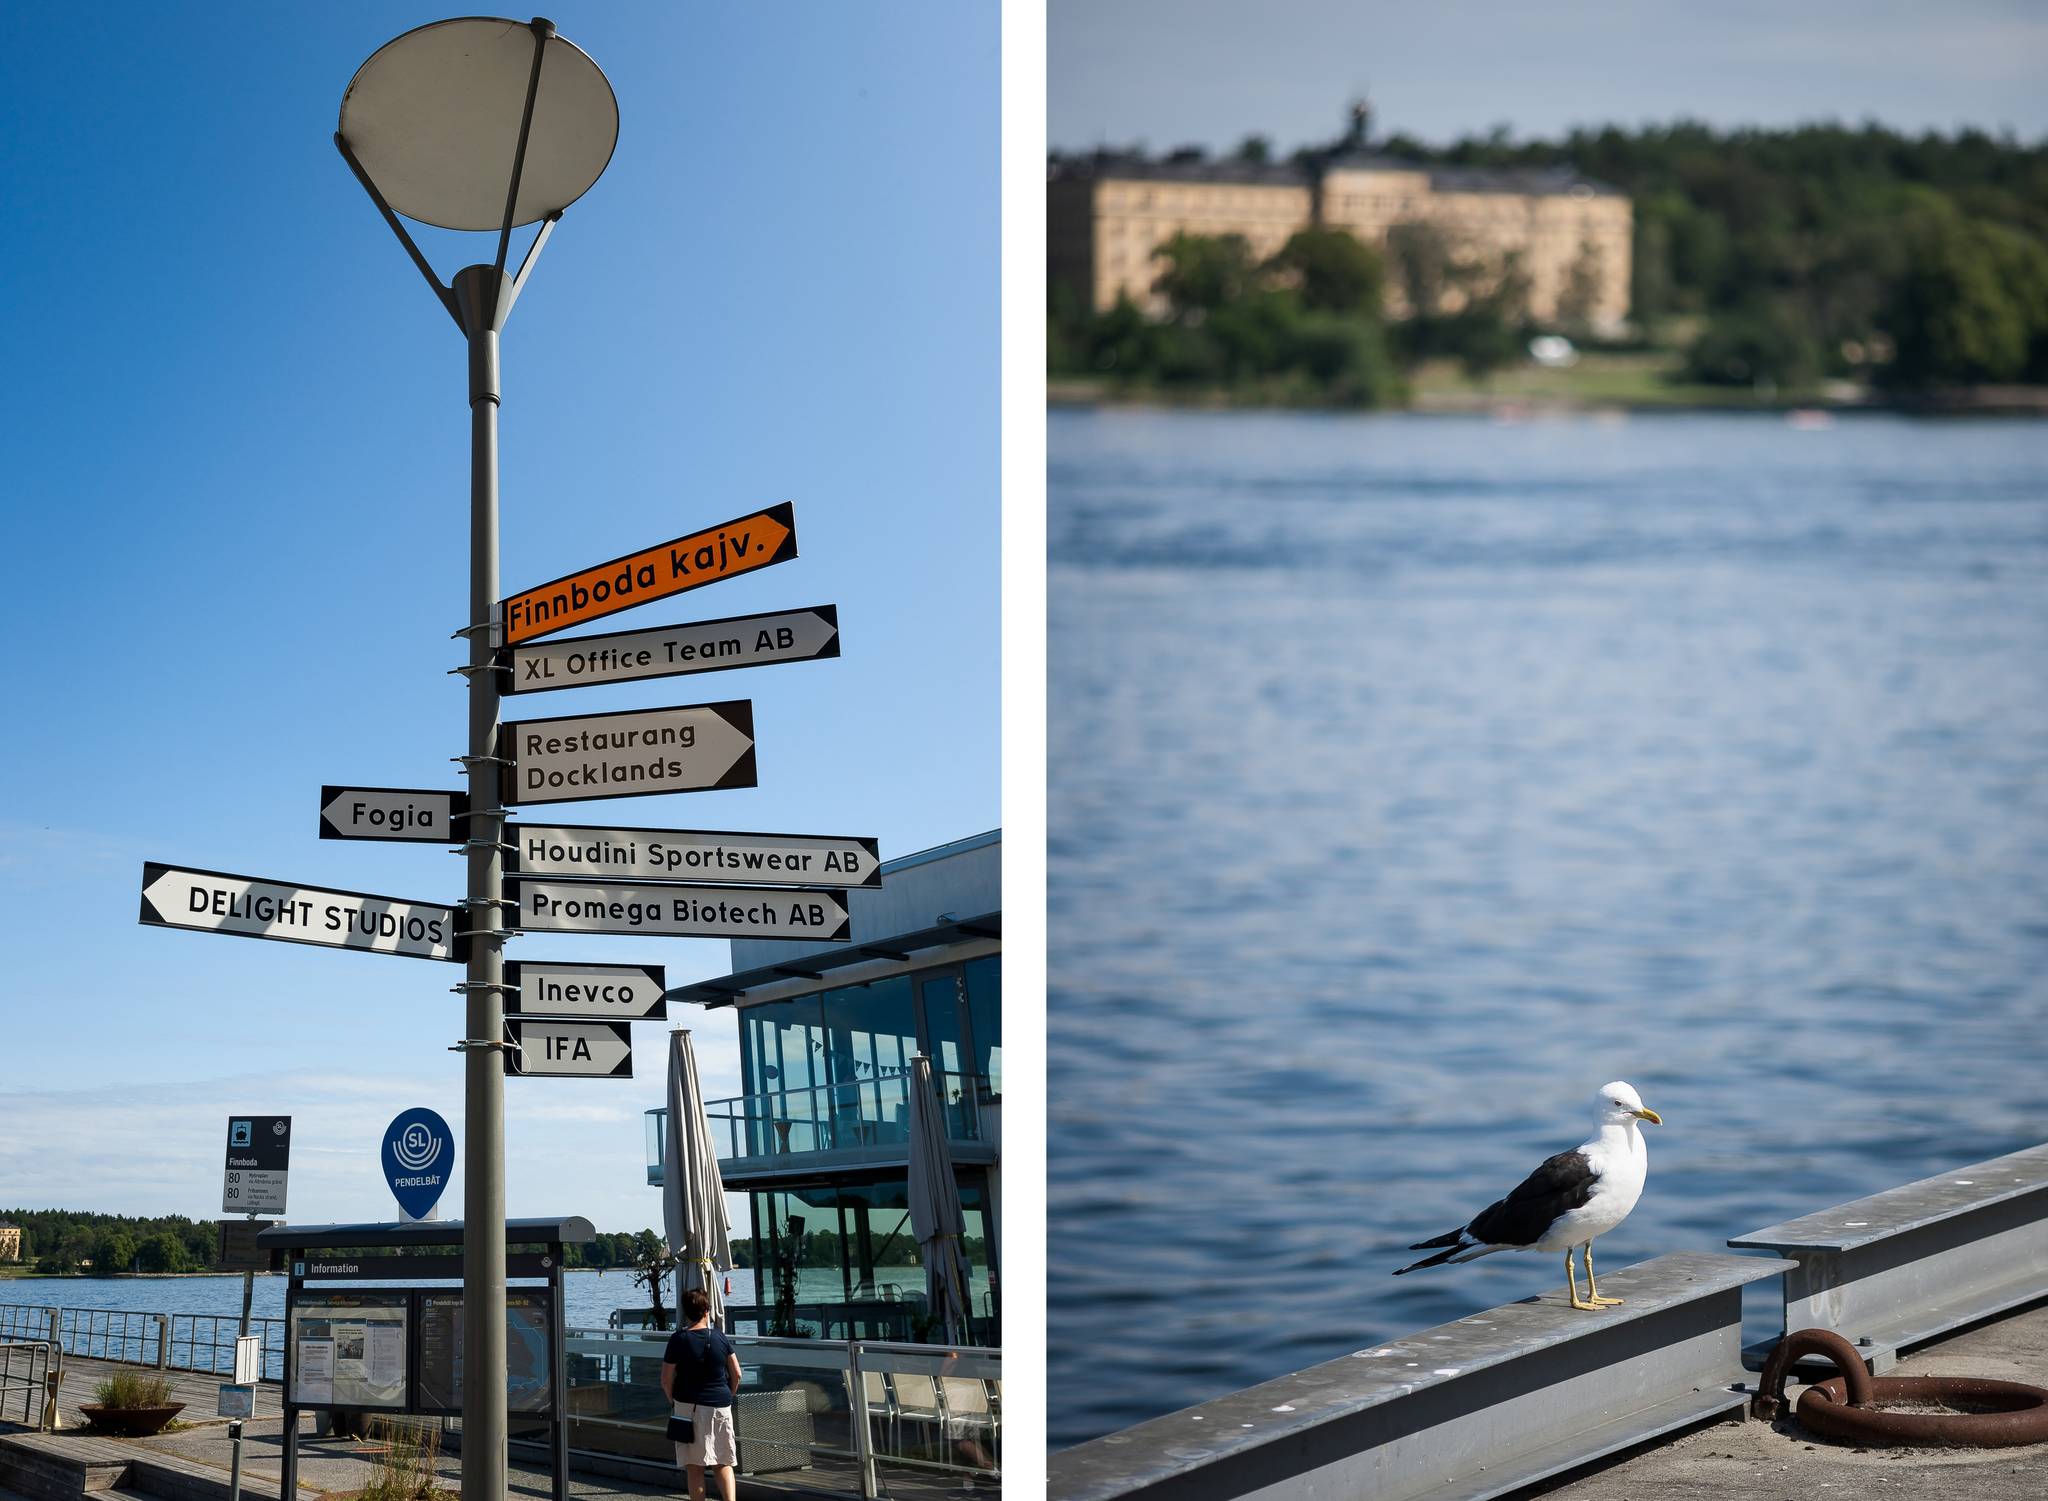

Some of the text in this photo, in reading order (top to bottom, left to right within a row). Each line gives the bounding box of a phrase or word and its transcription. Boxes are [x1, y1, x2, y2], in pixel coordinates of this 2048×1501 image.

[509, 532, 764, 632] Finnboda kajv.
[525, 627, 794, 680] XL Office Team AB
[526, 725, 695, 756] Restaurang
[527, 757, 682, 789] Docklands
[352, 803, 433, 831] Fogia
[528, 839, 860, 873] Houdini Sportswear AB
[189, 887, 442, 943] DELIGHT STUDIOS
[532, 893, 825, 926] Promega Biotech AB
[538, 978, 634, 1004] Inevco
[546, 1036, 592, 1061] IFA
[408, 1132, 426, 1148] SL
[229, 1157, 258, 1166] Finnboda
[228, 1172, 240, 1184] 80
[395, 1175, 441, 1188] PENDELBÅT
[227, 1187, 240, 1199] 80
[311, 1263, 359, 1274] Information
